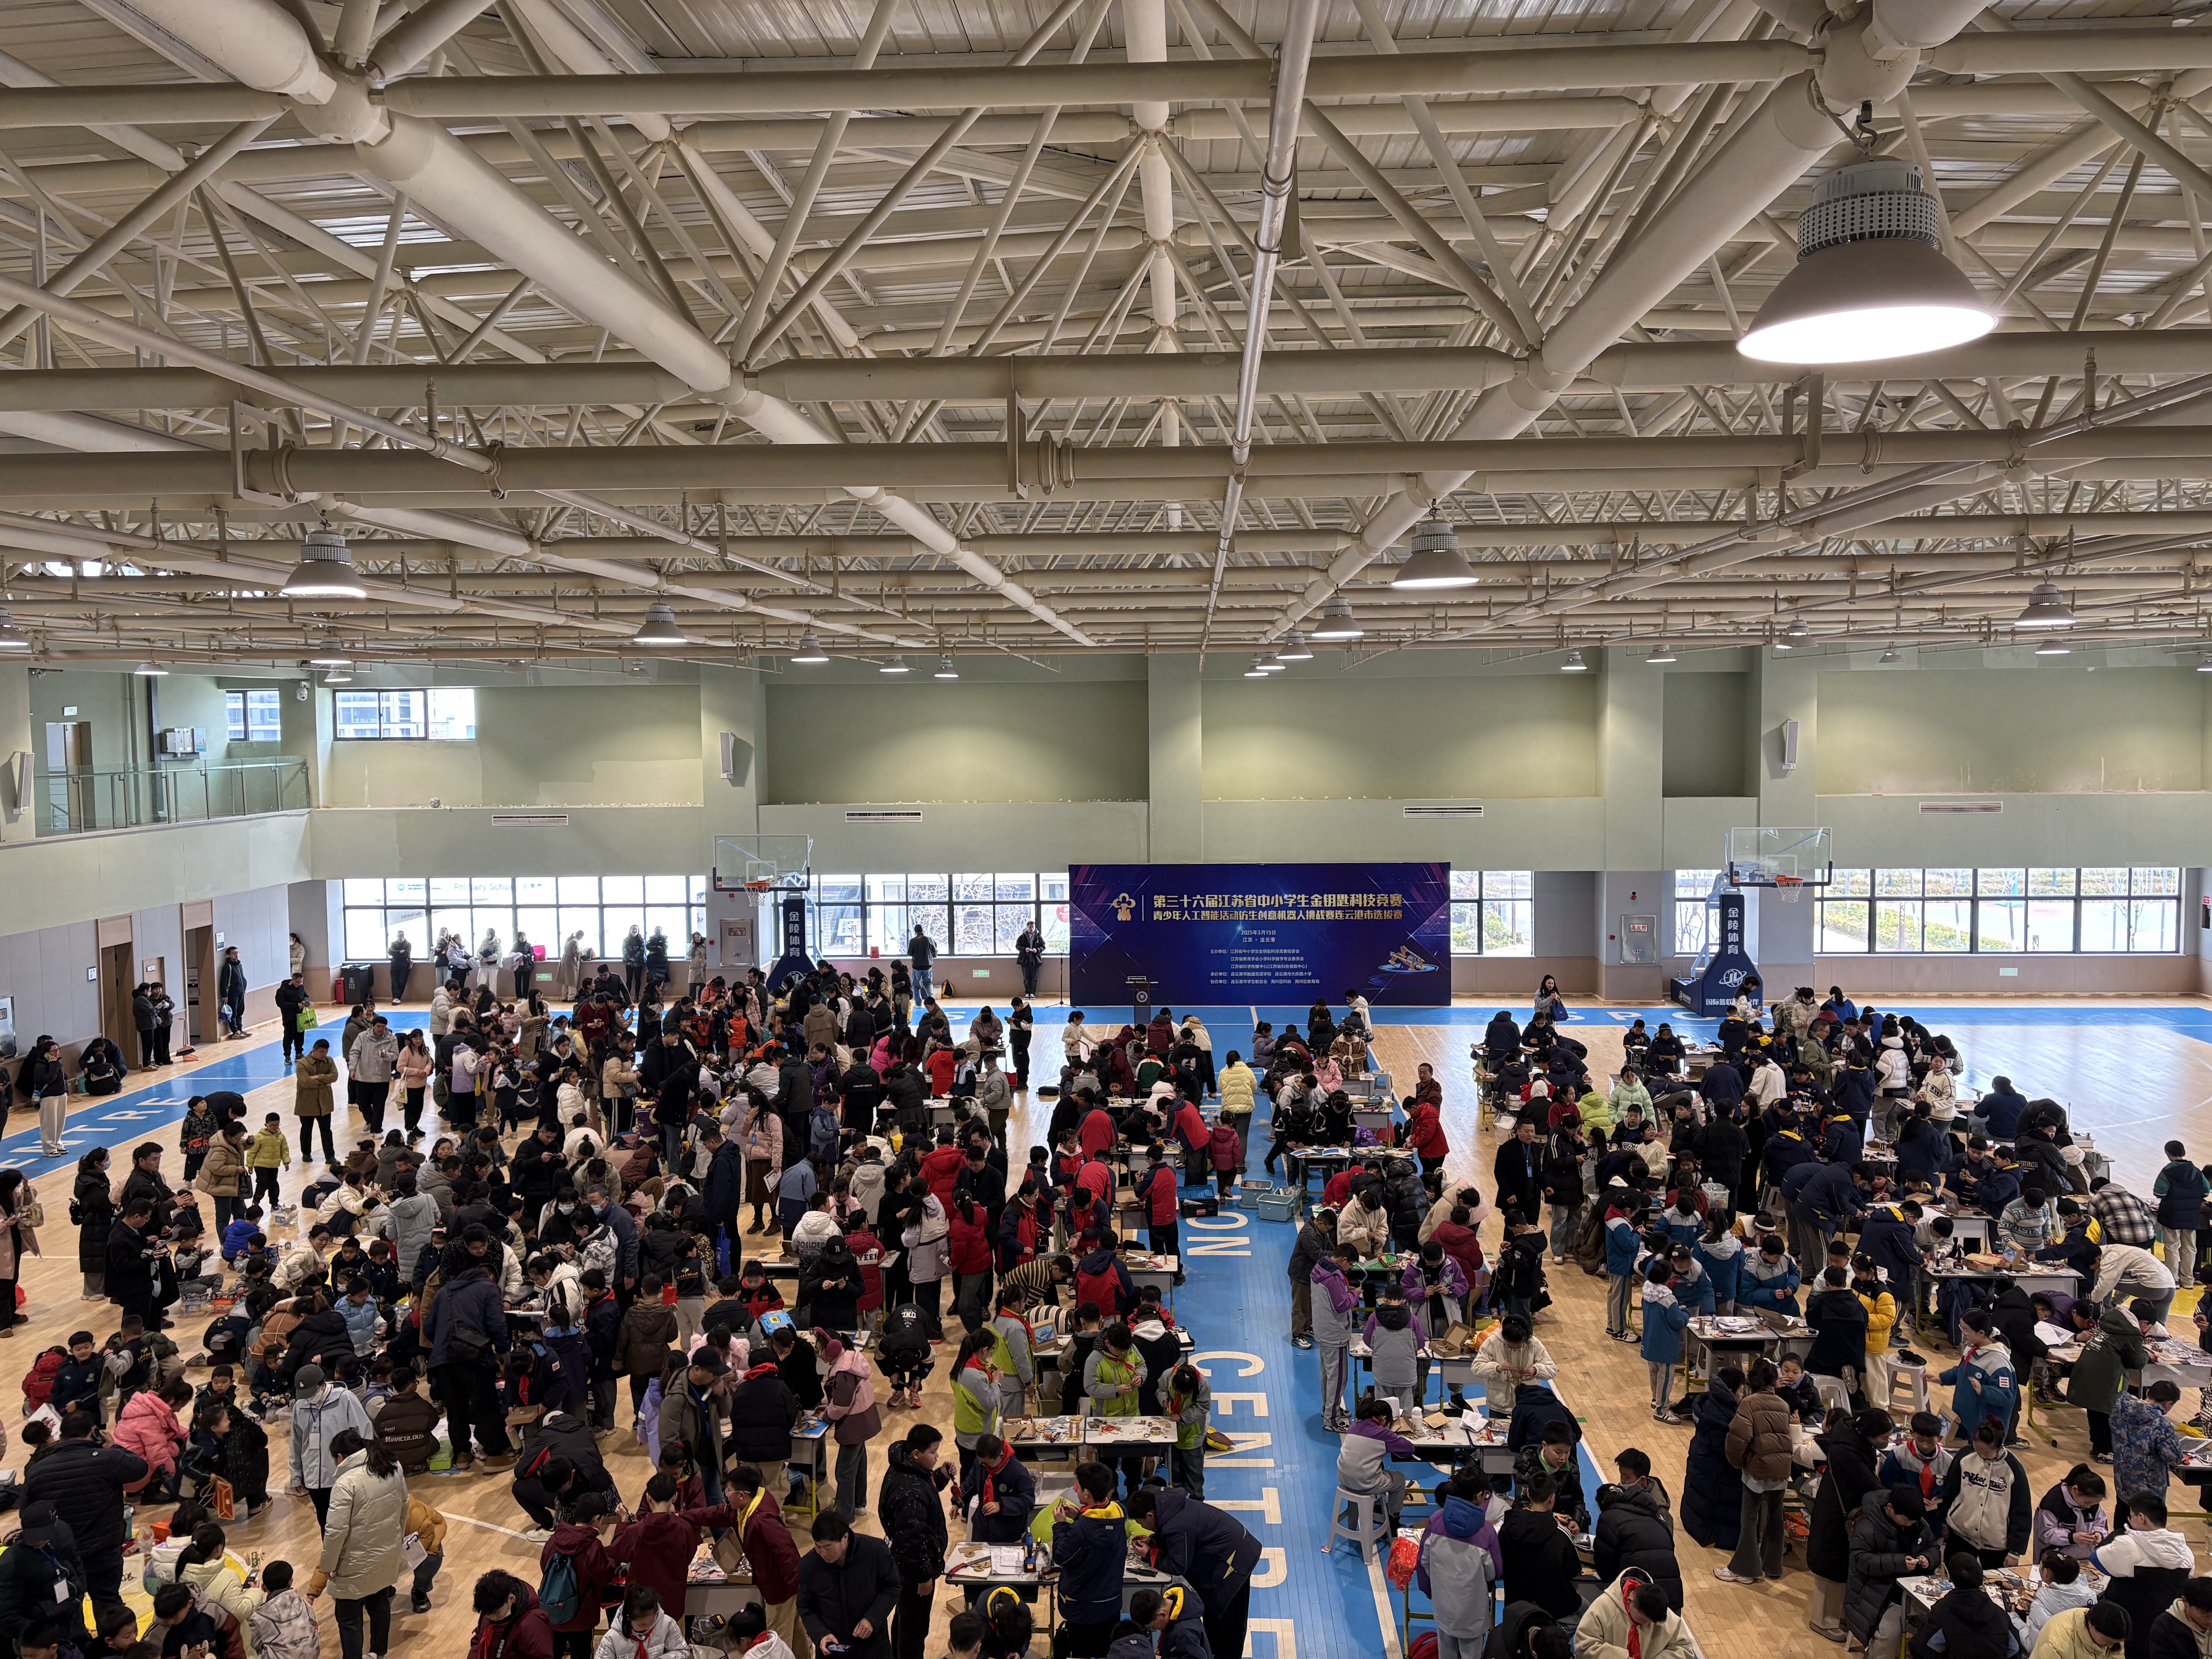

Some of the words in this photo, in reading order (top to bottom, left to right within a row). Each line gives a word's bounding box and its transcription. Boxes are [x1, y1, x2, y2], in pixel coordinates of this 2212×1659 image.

[455, 884, 486, 892] Priary
[1154, 894, 1402, 908] 第三十六届江苏省中小学生金钥匙科技竞赛
[1153, 910, 1402, 921] 青少年人工智能活动仿生创意机器人挑战赛连云港市选拔赛
[789, 912, 800, 957] 金陵体育
[1728, 908, 1739, 954] 金陵体育
